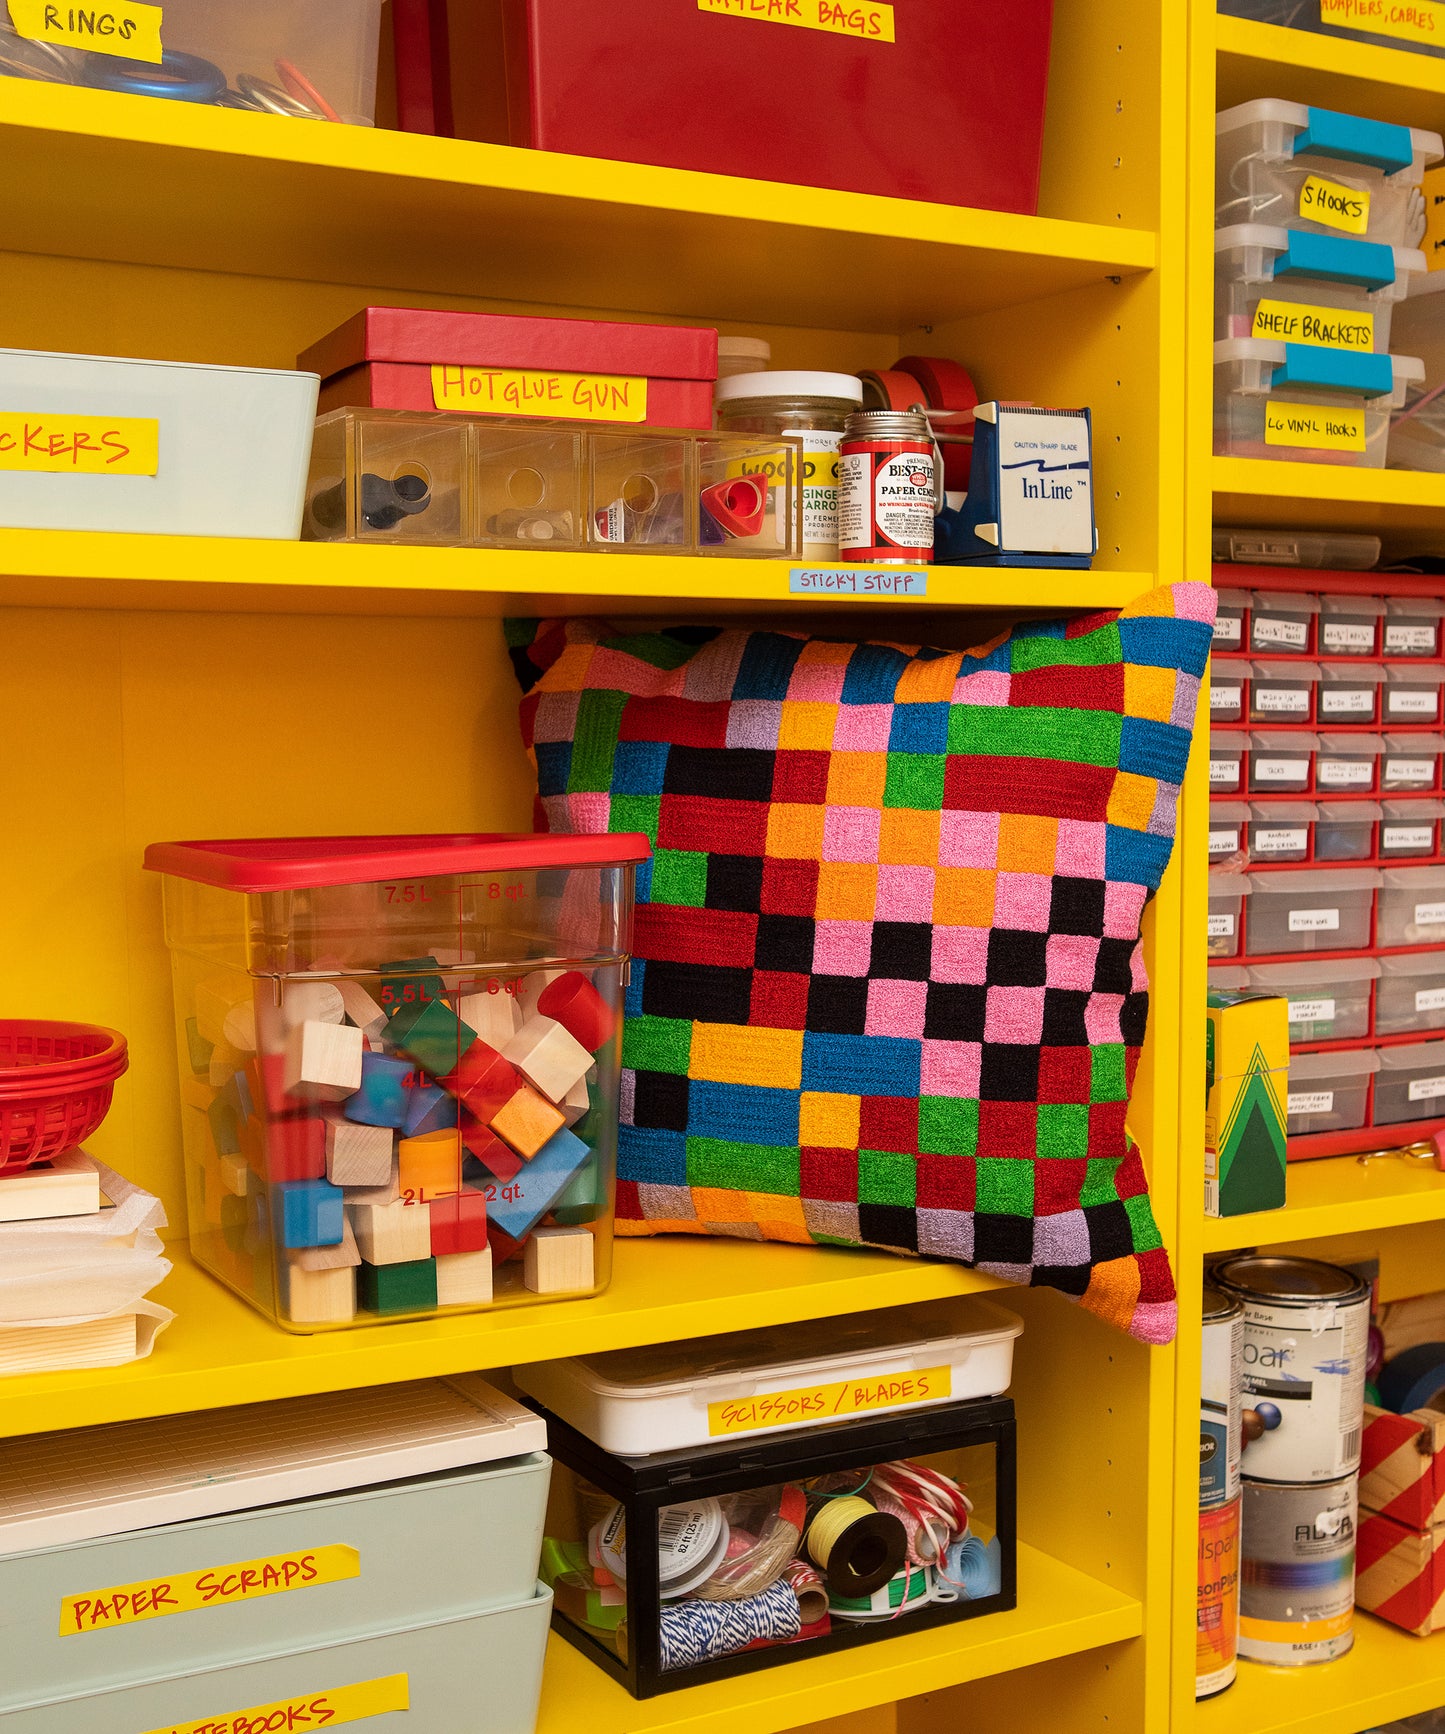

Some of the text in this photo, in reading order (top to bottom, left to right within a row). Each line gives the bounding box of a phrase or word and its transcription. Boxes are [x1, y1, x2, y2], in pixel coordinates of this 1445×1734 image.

[44, 4, 137, 40] RINGS
[818, 1, 882, 35] BAGS
[1316, 190, 1364, 218] HOOKS
[1256, 311, 1372, 345] SHELF BRACKETS
[503, 376, 563, 408] GLUE
[572, 379, 629, 412] GUN
[1267, 417, 1357, 437] LG VINYL HOOKS
[1014, 441, 1038, 449] CAUTION
[889, 465, 934, 478] BEST-TES
[803, 489, 838, 500] GINGE
[881, 486, 915, 495] PAPER
[1022, 477, 1073, 500] InLine
[863, 574, 914, 594] STUFF
[384, 885, 416, 903] 7.5
[487, 881, 529, 902] 8 qt.
[381, 985, 416, 1003] 5.5
[486, 977, 528, 999] 6 qt.
[401, 1071, 416, 1088] 4
[403, 1188, 416, 1207] 2
[485, 1182, 525, 1203] 2 qt.
[1254, 1311, 1274, 1321] Base
[720, 1392, 826, 1427] SCISSORS
[854, 1376, 930, 1406] BLADES
[677, 1543, 690, 1554] 82
[682, 1534, 693, 1545] ft
[72, 1555, 318, 1630] PAPER SCRAPS
[1292, 1643, 1313, 1651] BASE
